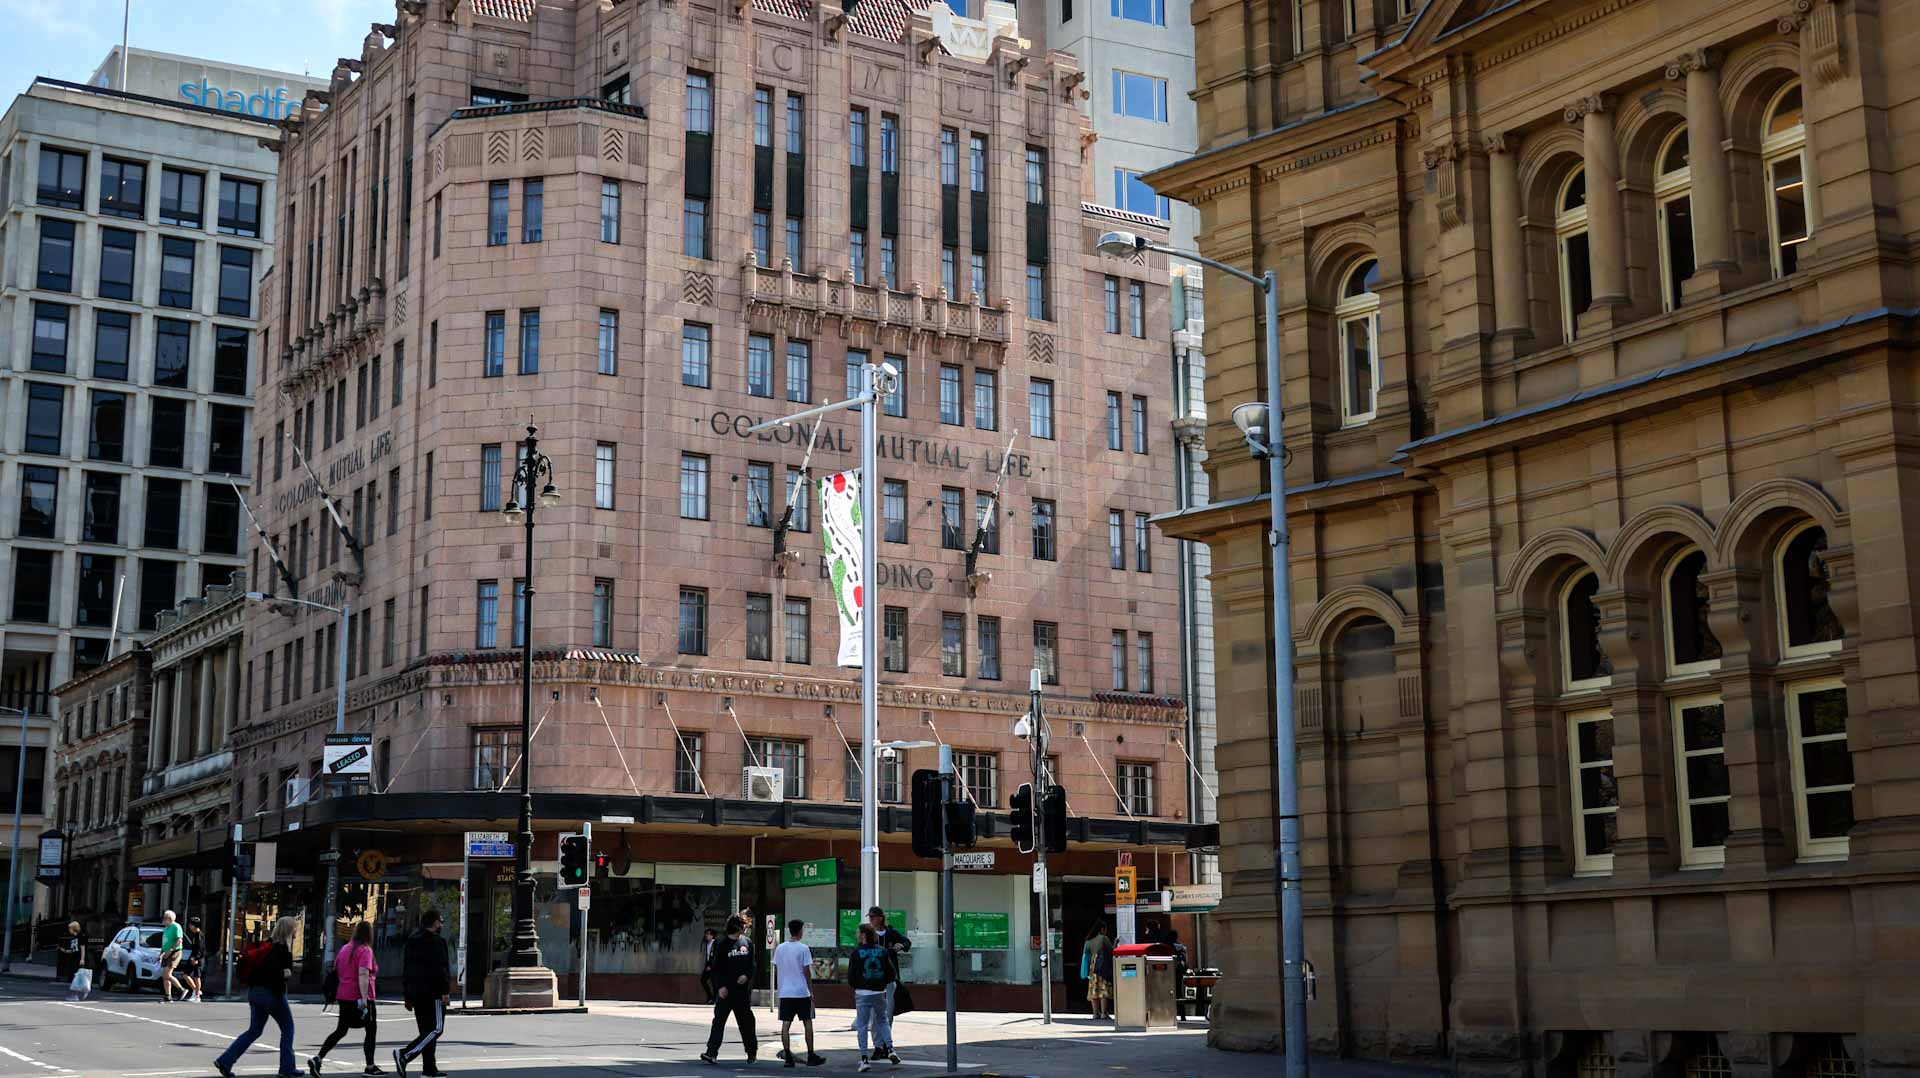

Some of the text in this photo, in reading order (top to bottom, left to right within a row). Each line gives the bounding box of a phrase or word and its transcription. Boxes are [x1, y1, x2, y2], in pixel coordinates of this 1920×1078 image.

[329, 447, 365, 487] MUTUAL
[370, 431, 392, 464] LIFE
[336, 751, 361, 769] LEASED
[471, 833, 500, 841] ELIZABETH
[955, 854, 985, 864] MACQUARIE
